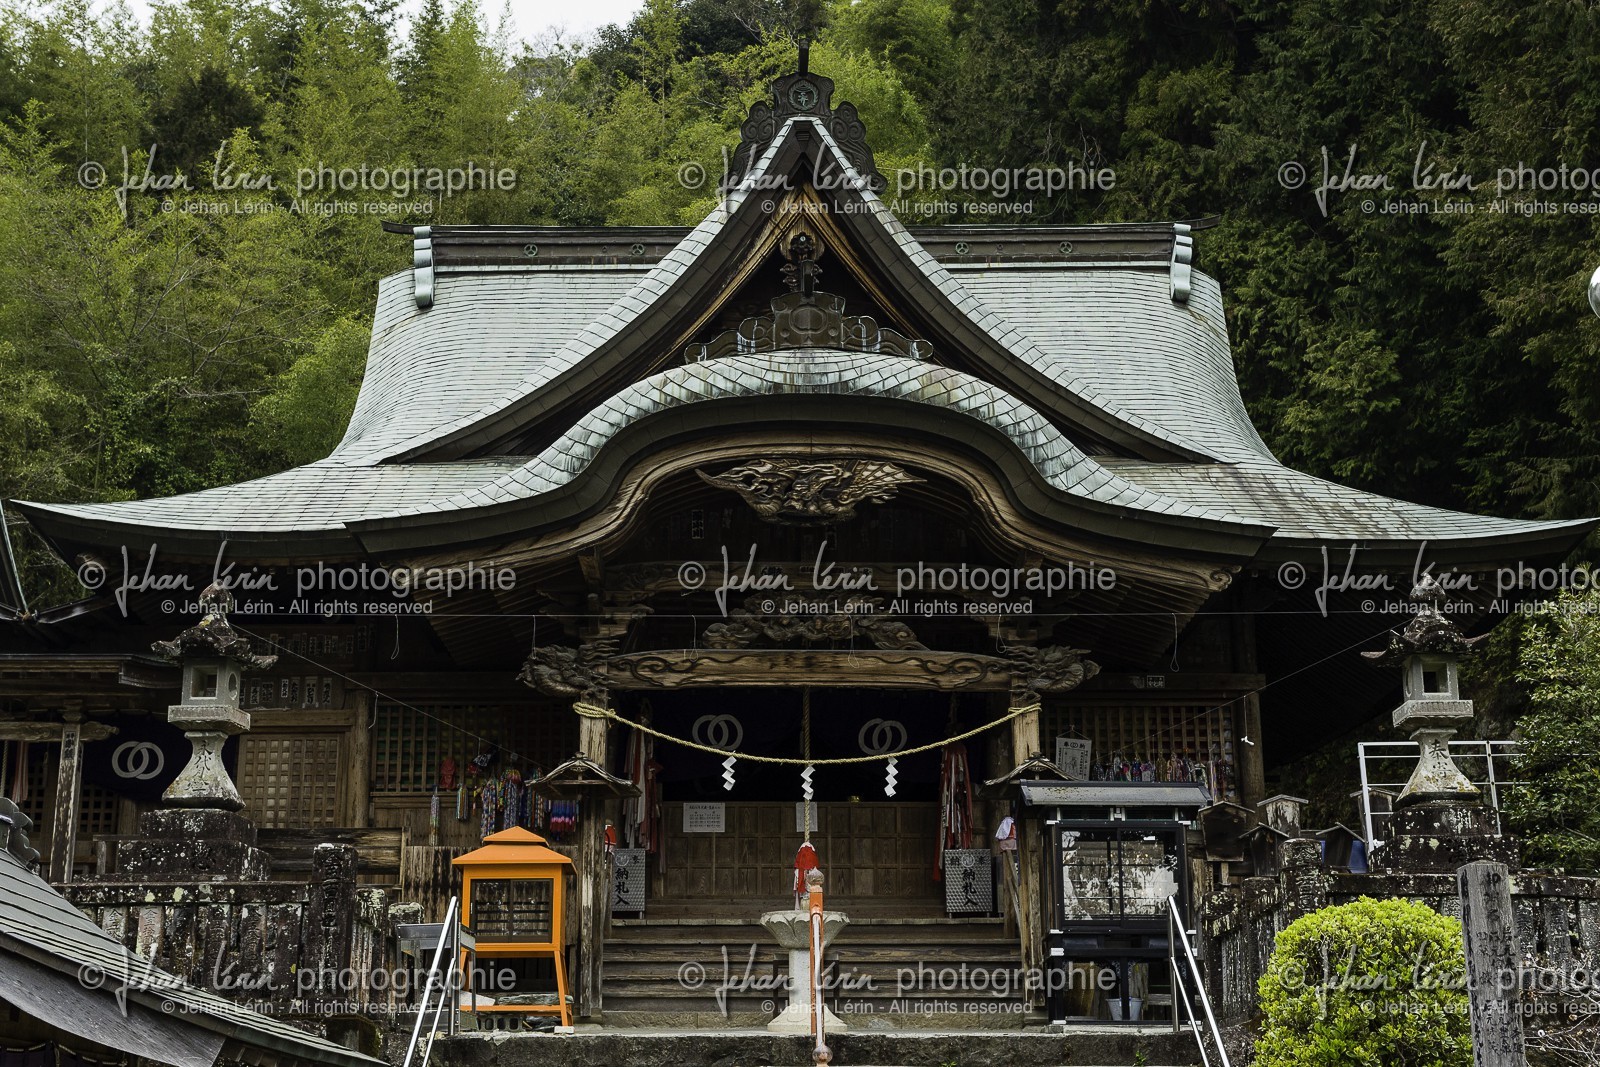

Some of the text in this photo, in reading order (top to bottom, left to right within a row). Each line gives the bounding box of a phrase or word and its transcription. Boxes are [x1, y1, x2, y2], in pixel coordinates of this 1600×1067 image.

[615, 867, 630, 906] 納札入
[961, 868, 979, 907] 納札入
